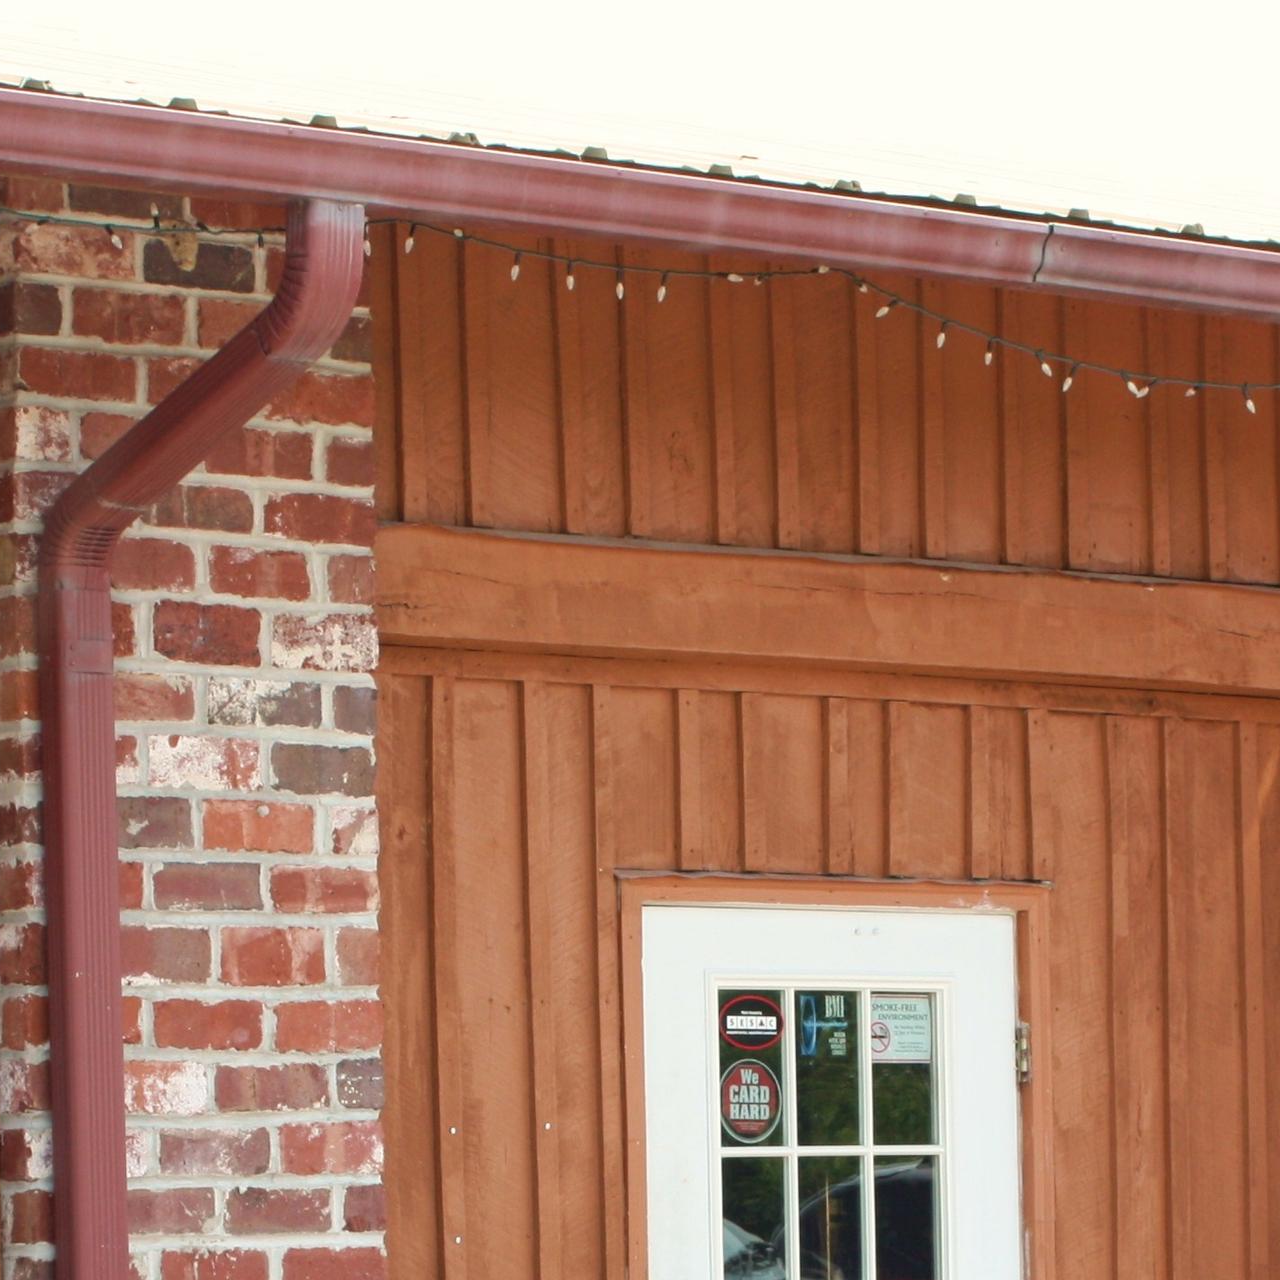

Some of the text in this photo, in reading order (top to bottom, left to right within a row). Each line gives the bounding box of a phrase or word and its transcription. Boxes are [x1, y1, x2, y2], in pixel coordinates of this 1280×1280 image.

[740, 1069, 759, 1085] We
[729, 1084, 770, 1103] CARD
[730, 1103, 770, 1120] HARD
